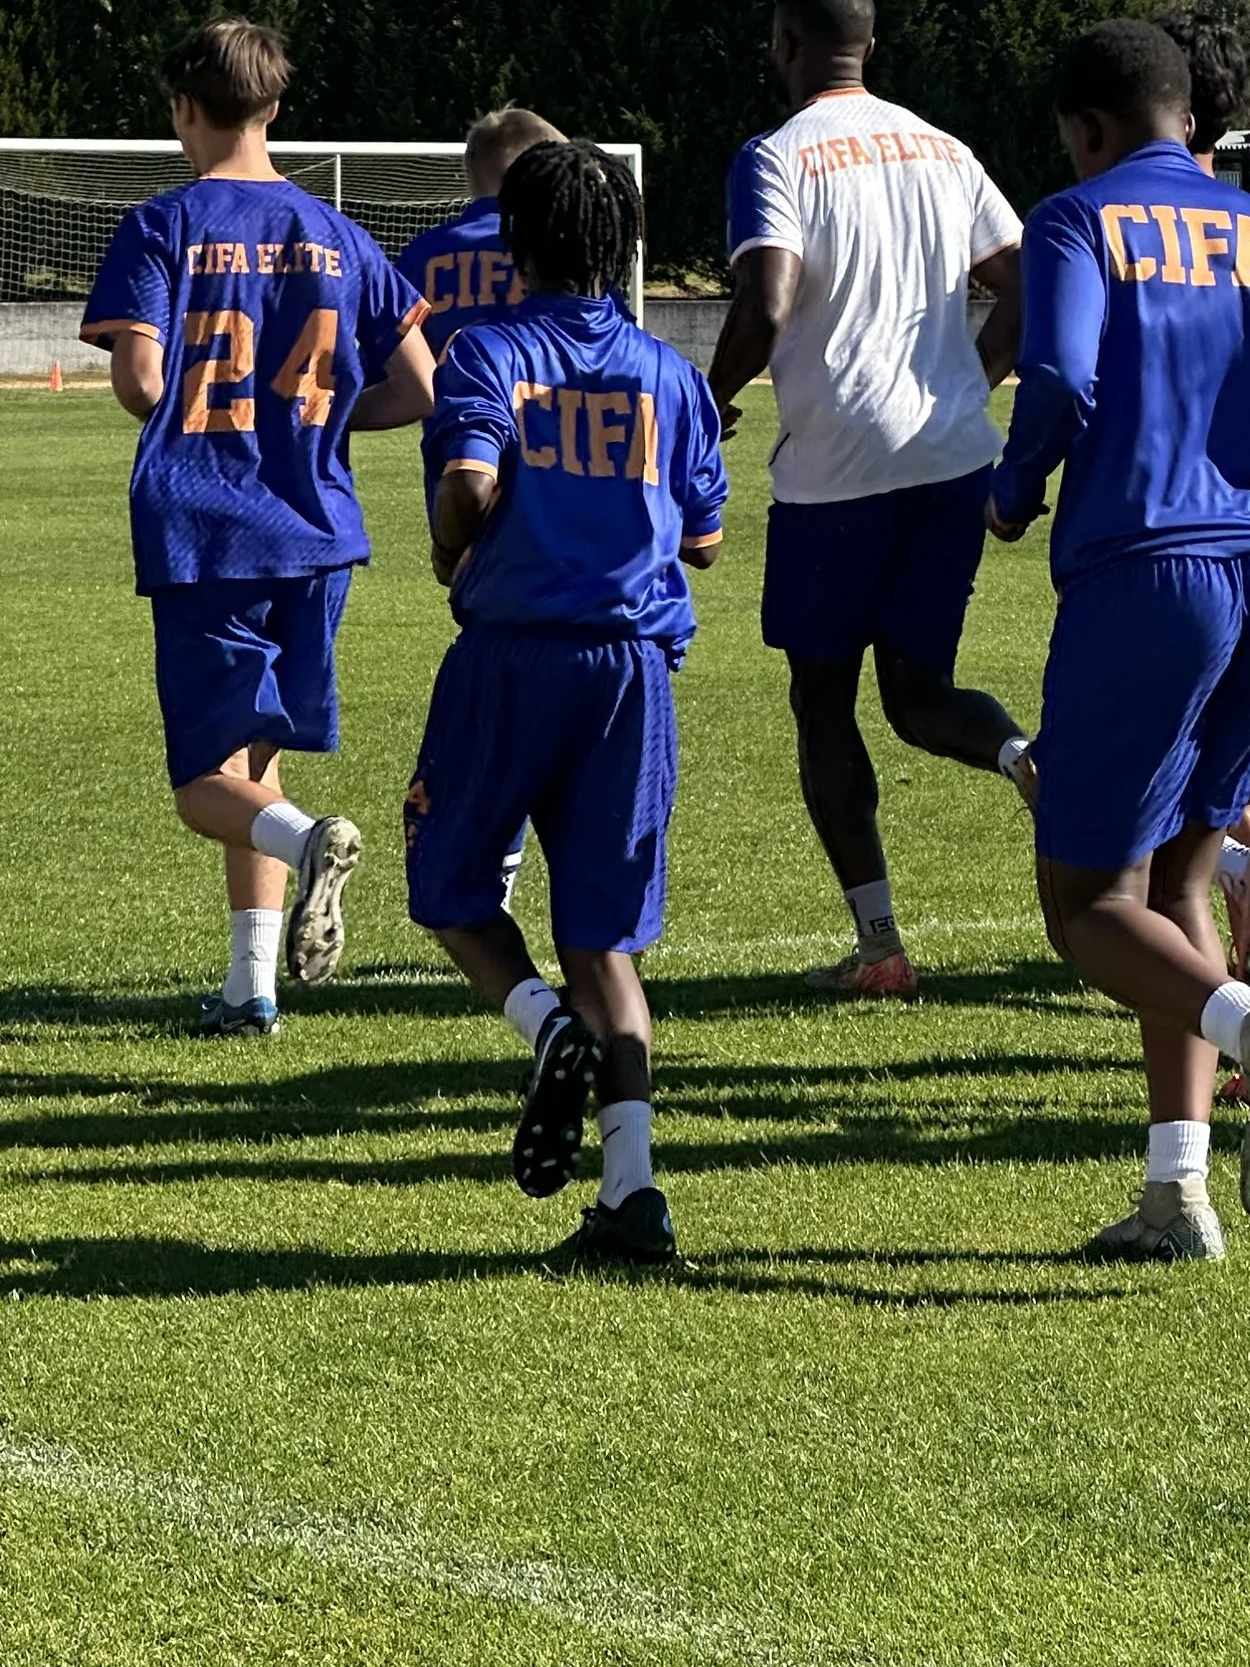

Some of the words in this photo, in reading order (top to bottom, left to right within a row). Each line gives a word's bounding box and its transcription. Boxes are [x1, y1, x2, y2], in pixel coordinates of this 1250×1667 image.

[798, 136, 873, 179] CIFA
[870, 132, 966, 166] ELITE
[187, 243, 250, 275] CIFA
[256, 241, 343, 278] ELITE
[183, 307, 340, 435] 24
